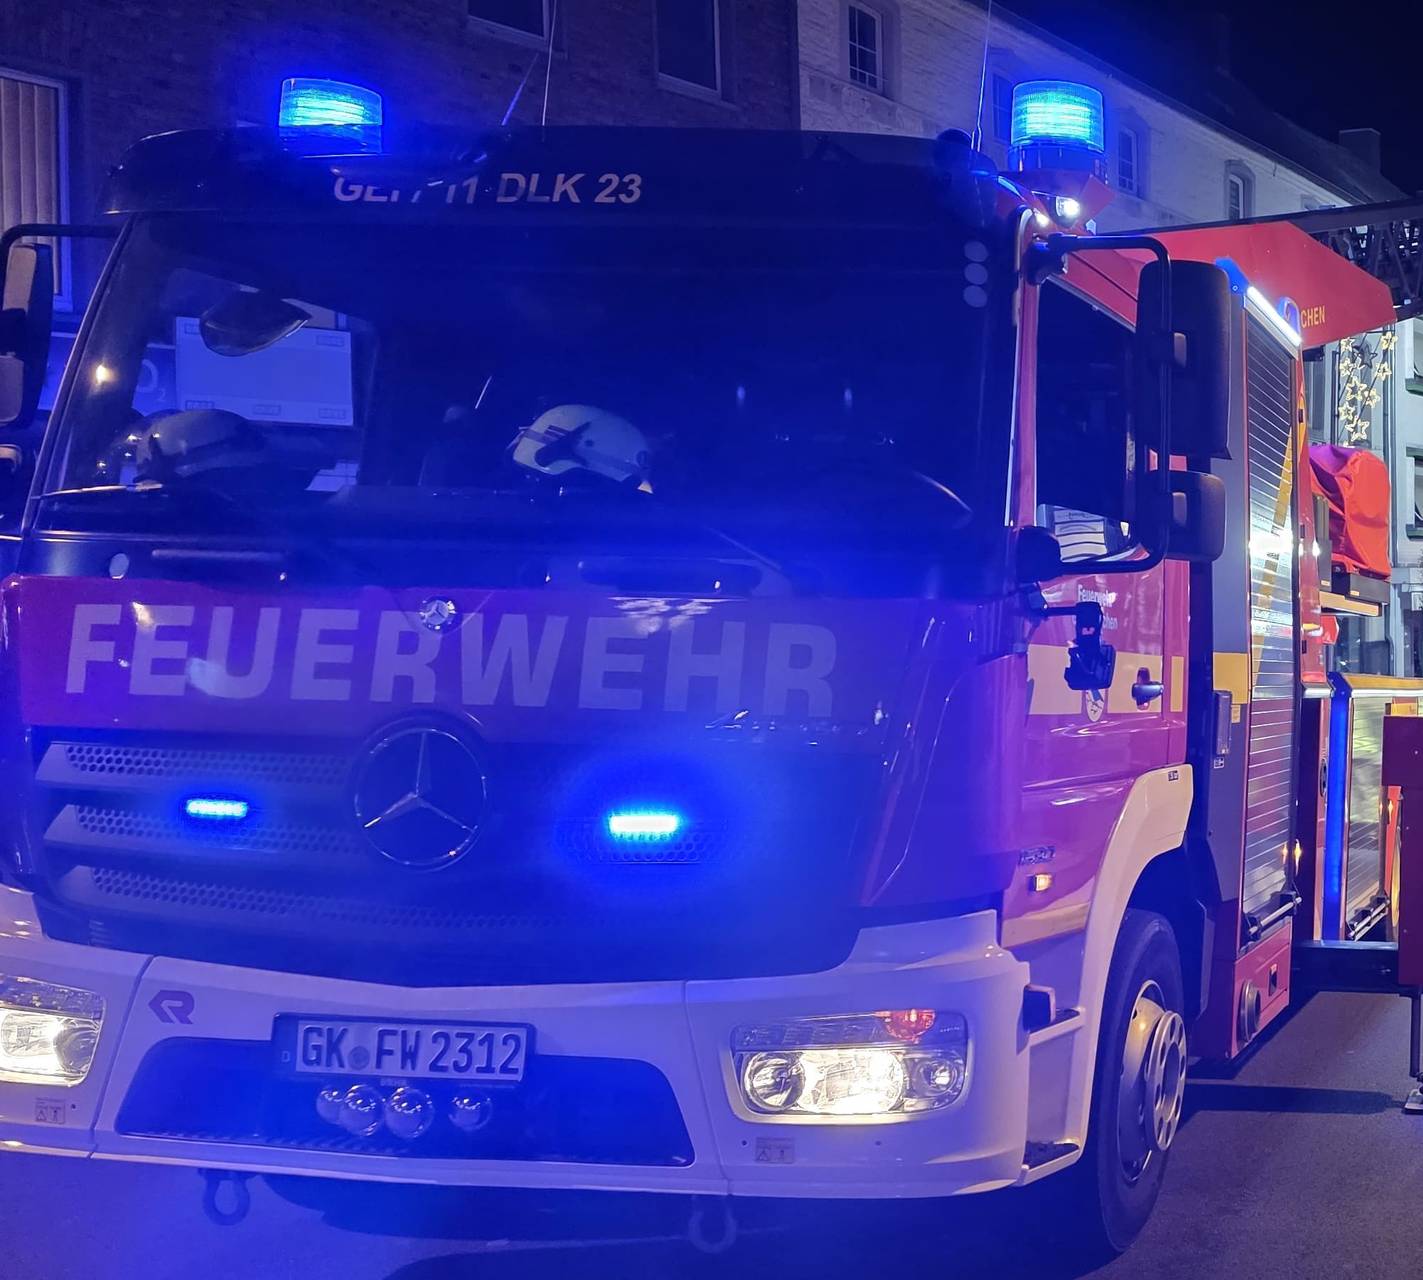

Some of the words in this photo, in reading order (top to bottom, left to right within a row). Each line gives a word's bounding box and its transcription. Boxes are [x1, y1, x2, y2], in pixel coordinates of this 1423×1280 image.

[496, 173, 585, 204] DLK
[594, 173, 643, 204] 23
[65, 603, 838, 718] FEUERWEHR
[302, 1025, 349, 1069] GK
[375, 1028, 422, 1072] FW
[428, 1031, 522, 1075] 2312
